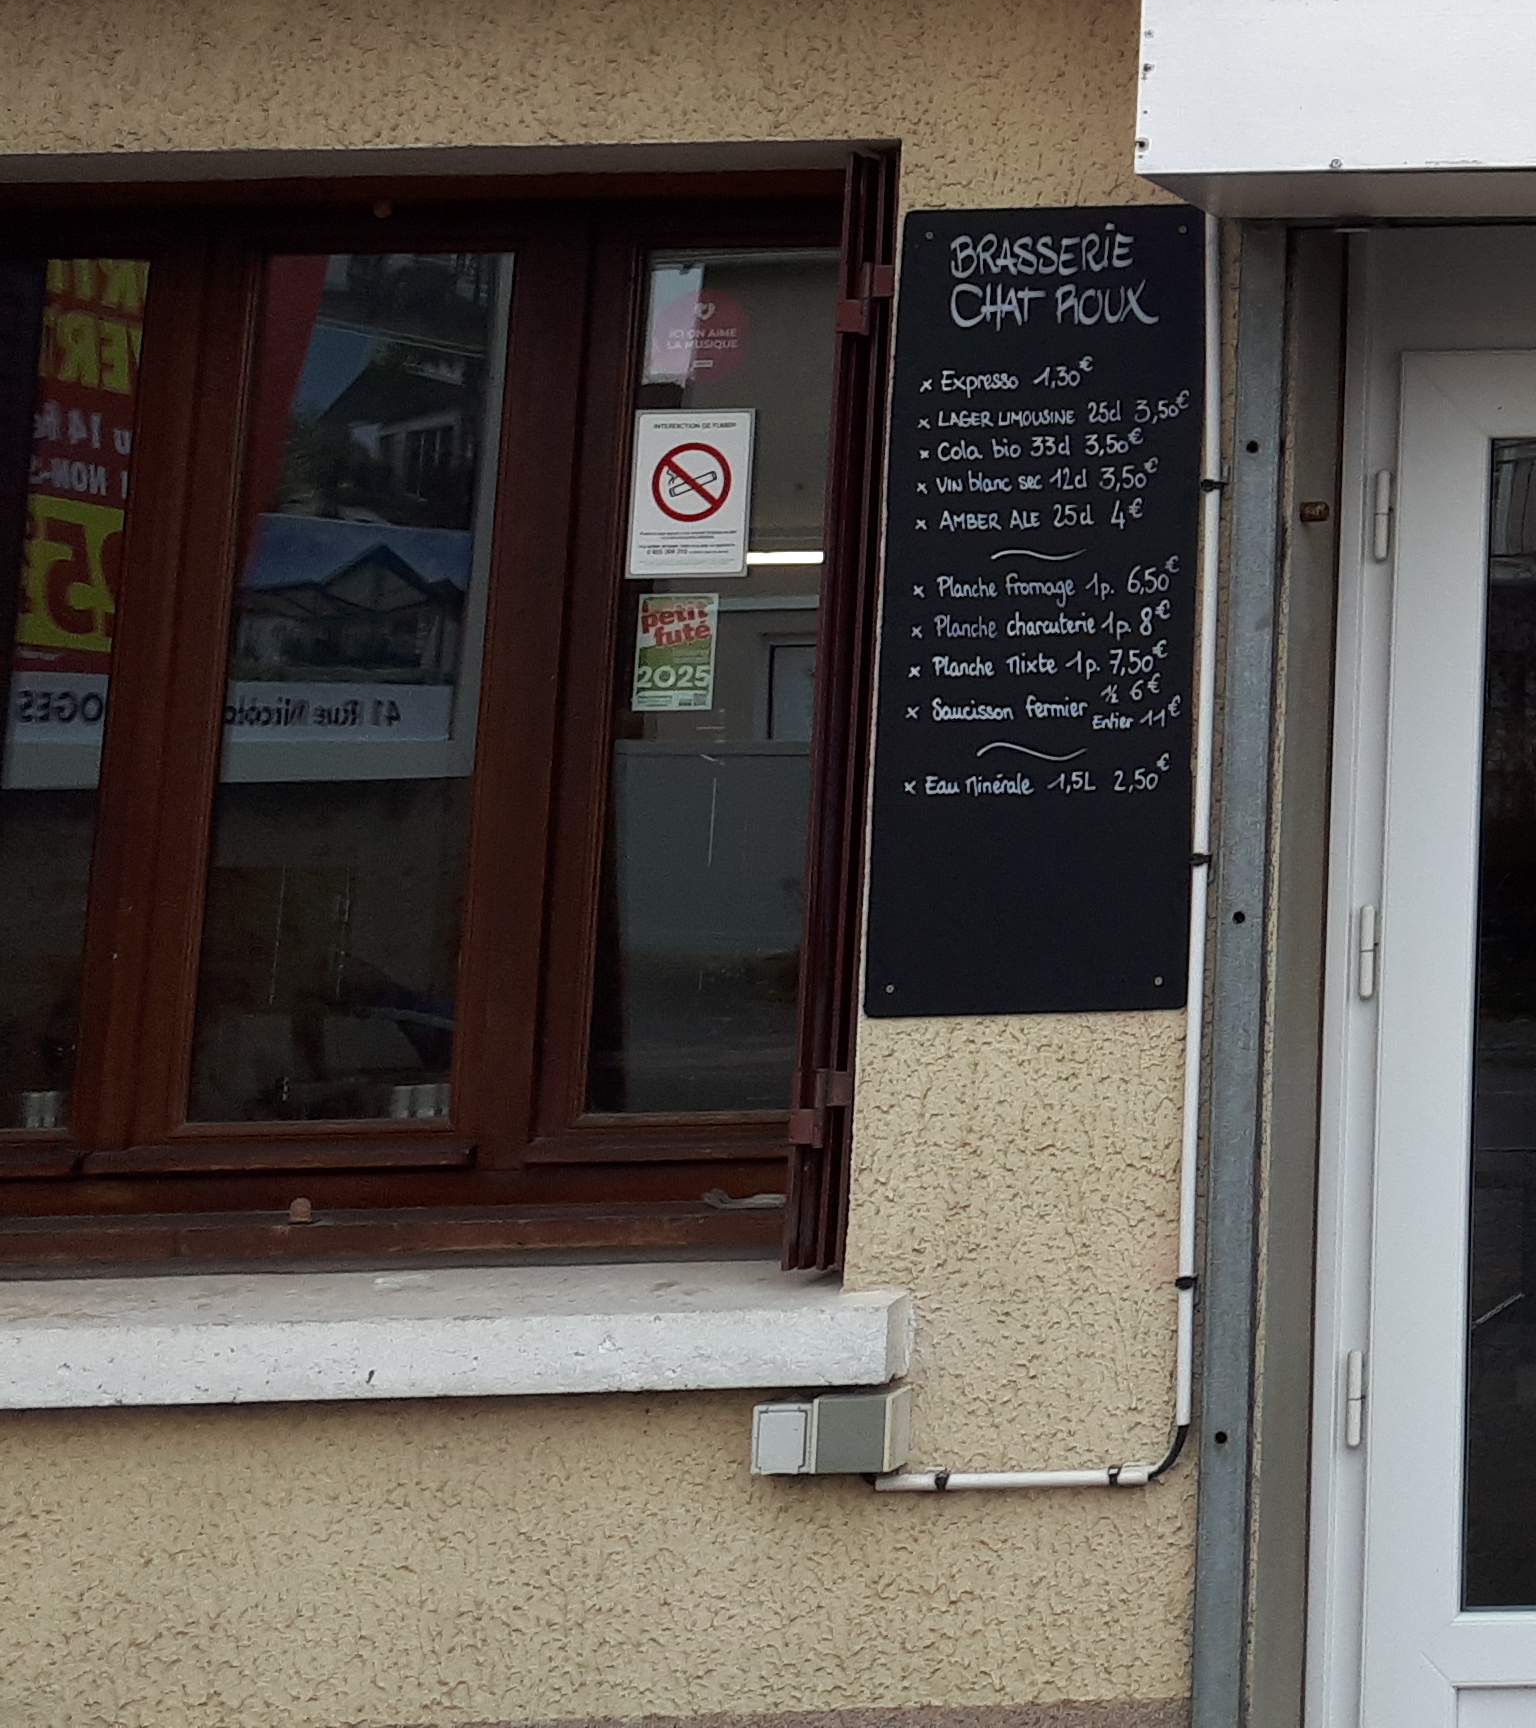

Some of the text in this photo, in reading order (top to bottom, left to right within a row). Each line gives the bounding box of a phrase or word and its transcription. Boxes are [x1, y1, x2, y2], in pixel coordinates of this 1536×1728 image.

[951, 223, 1133, 278] BRASSERIE
[951, 280, 1158, 331] CHAT ROUX
[941, 371, 1018, 398] Expresso
[938, 411, 994, 427] LAGER
[999, 409, 1074, 427] LIMOUSINE
[938, 440, 983, 461] Cola
[992, 438, 1021, 458] bio
[968, 470, 1012, 492] blanc
[1018, 475, 1042, 489] sec
[940, 511, 1001, 531] AMBER
[1010, 510, 1040, 529] ALE
[937, 576, 997, 597] Planche
[1006, 573, 1075, 607] fromage
[654, 619, 711, 646] futé
[934, 615, 997, 638] Planche
[1007, 612, 1095, 636] charcuterie
[637, 665, 710, 688] 2025
[932, 656, 994, 676] Planche
[932, 698, 1013, 721] Saucisson
[1026, 695, 1088, 717] fermier
[1092, 713, 1133, 729] Entier
[925, 776, 959, 794] Eau
